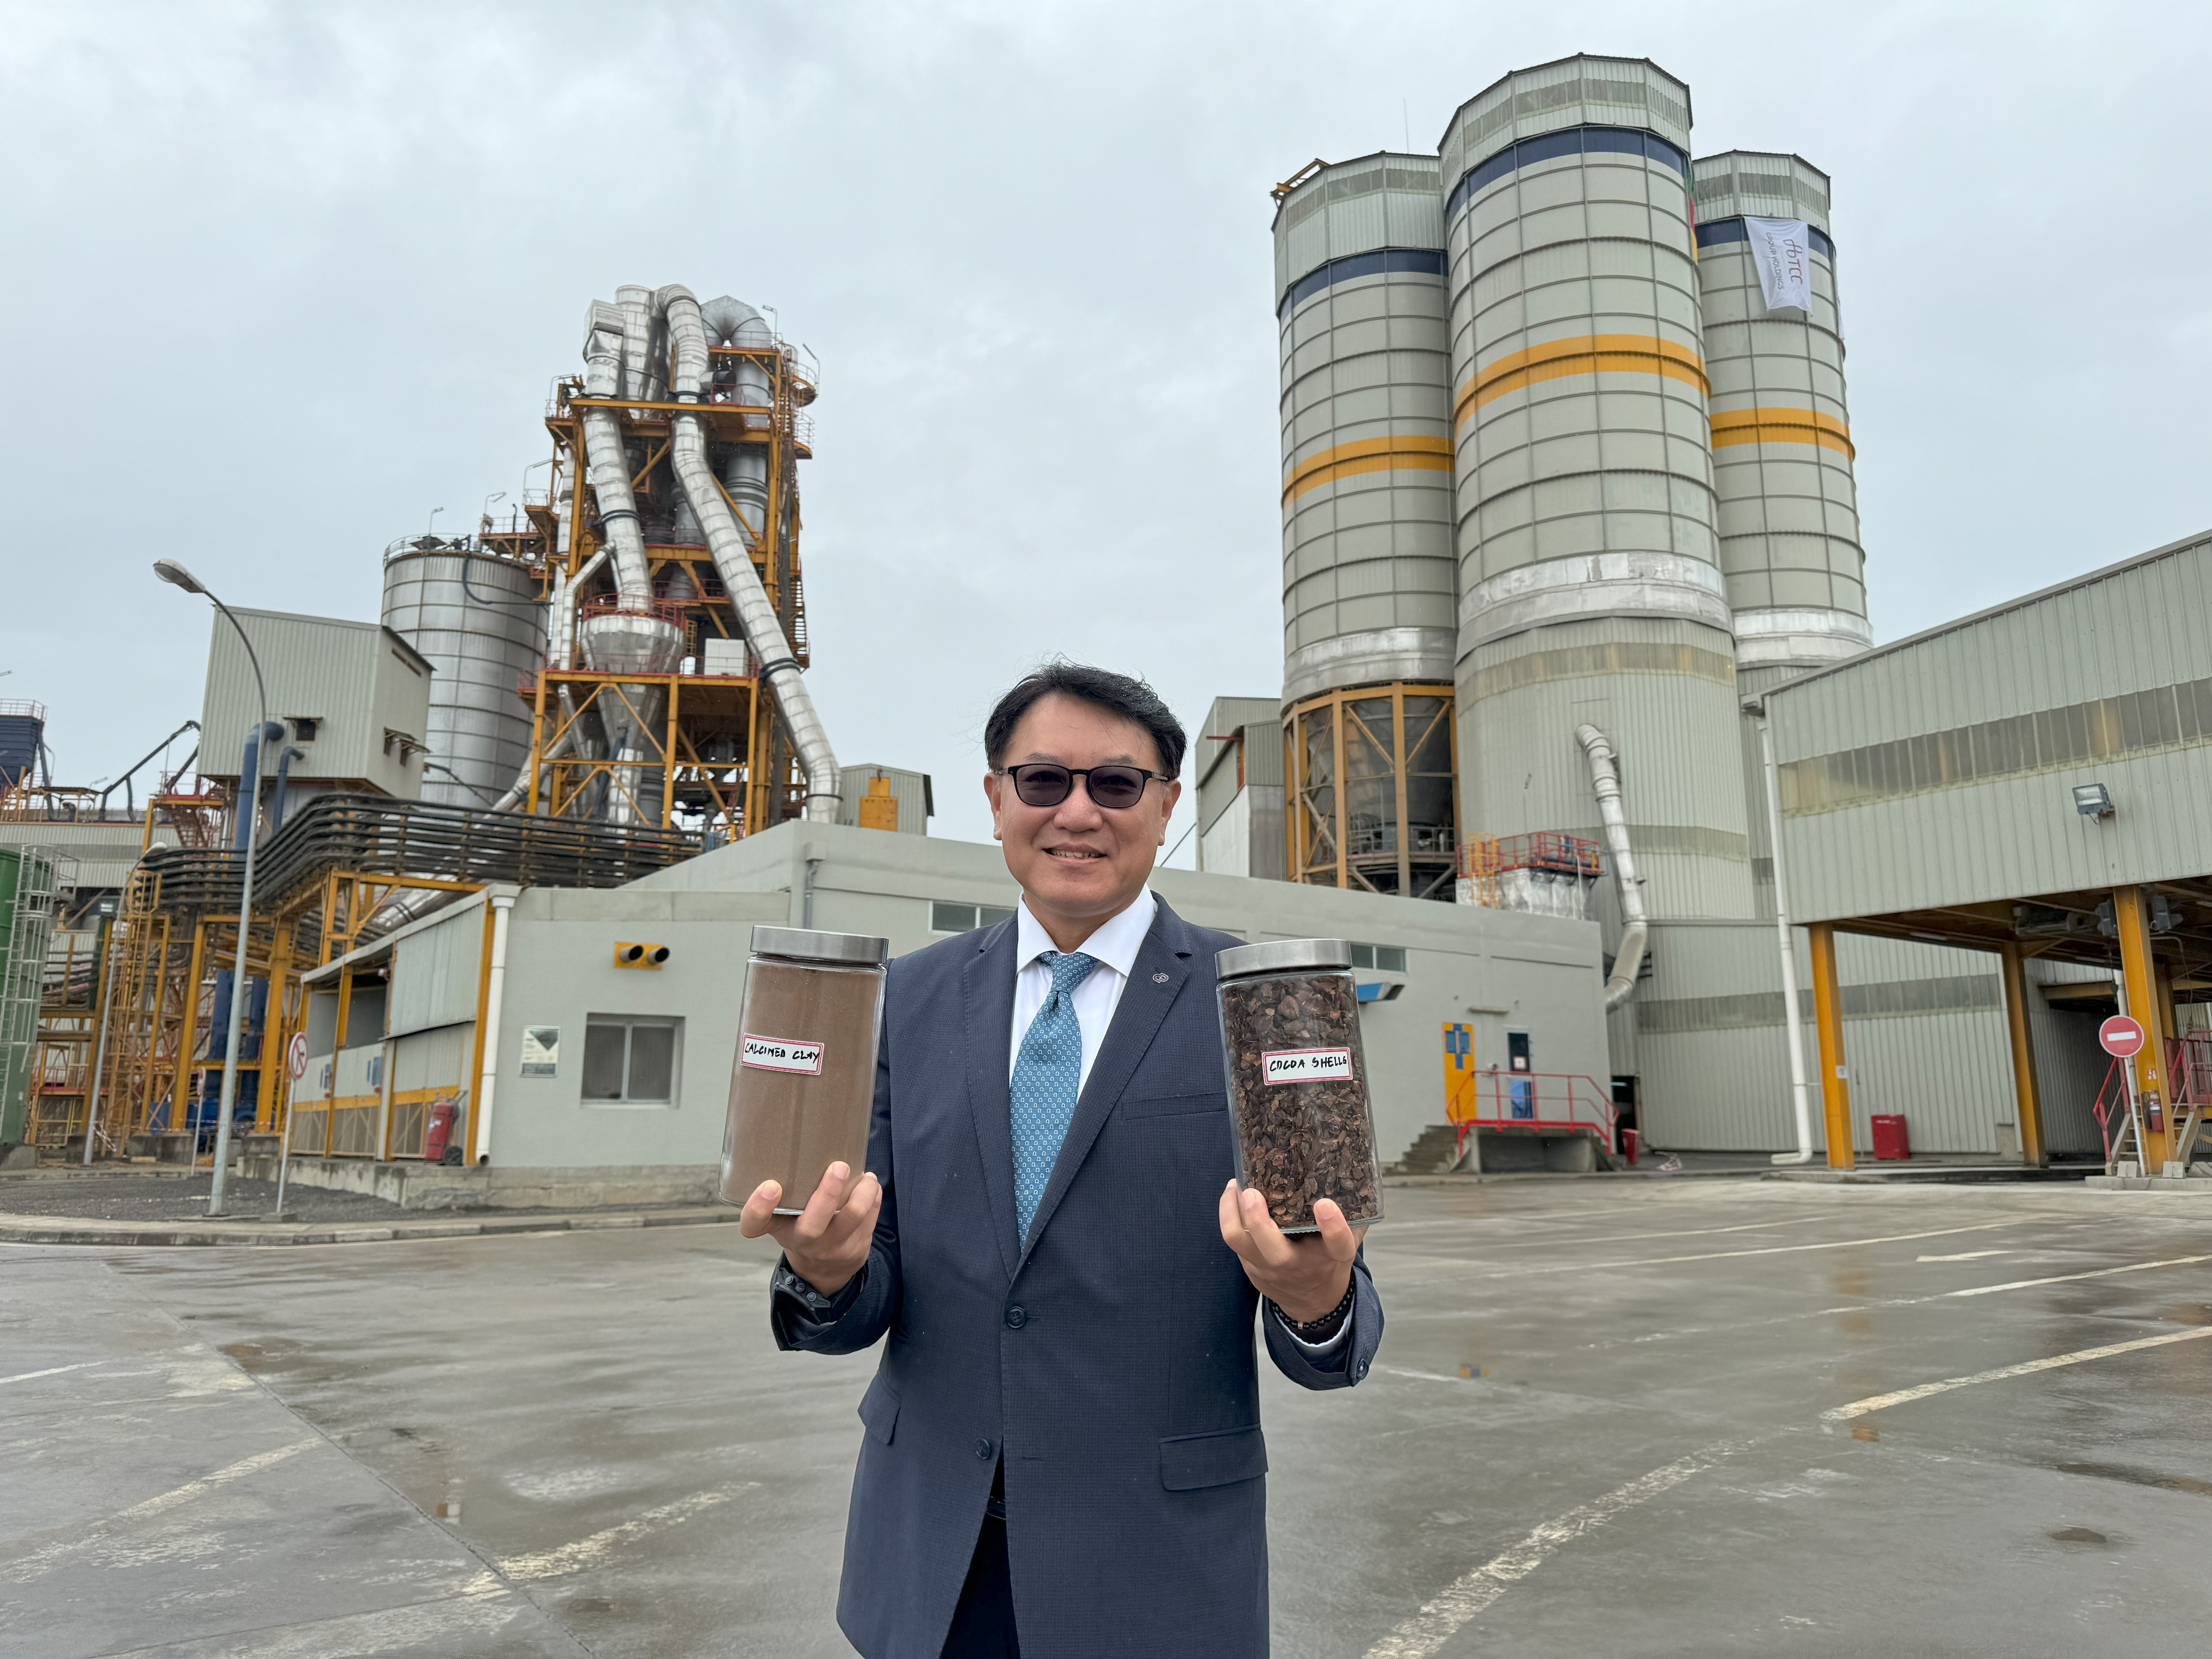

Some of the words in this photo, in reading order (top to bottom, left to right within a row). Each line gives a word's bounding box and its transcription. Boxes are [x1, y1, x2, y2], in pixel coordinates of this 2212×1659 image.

[1765, 232, 1777, 255] GROUP
[1772, 256, 1784, 290] HOLDINGS
[744, 1042, 786, 1058] CALCINED
[792, 1050, 820, 1064] CLAY
[1269, 1059, 1305, 1072] COCOA
[1311, 1056, 1347, 1068] SHELLS
